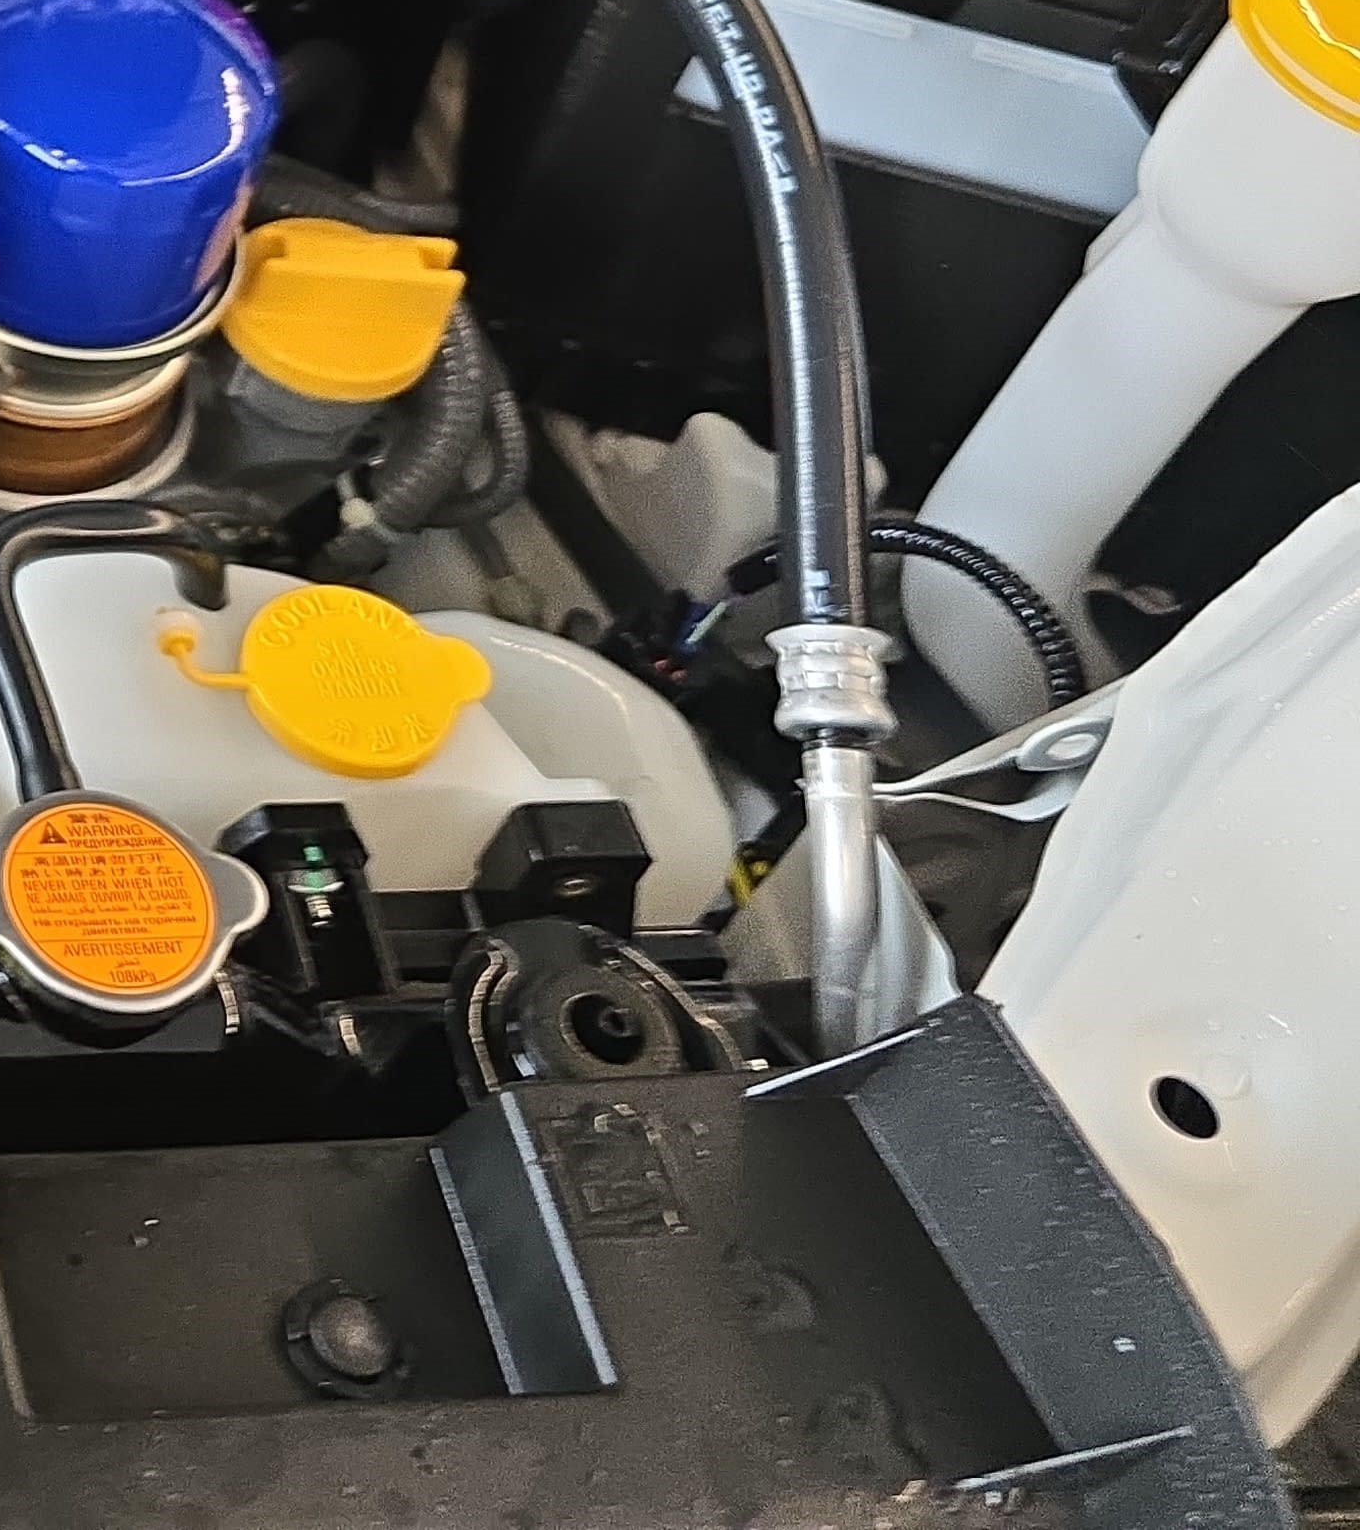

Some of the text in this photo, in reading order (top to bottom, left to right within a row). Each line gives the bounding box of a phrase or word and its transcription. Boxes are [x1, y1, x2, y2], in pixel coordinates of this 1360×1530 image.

[258, 592, 422, 648] COOLANT
[65, 823, 144, 837] WARNING
[22, 876, 184, 892] NEVER OPEN WHEN HOT
[26, 892, 41, 904] NE
[47, 891, 86, 904] JAMAIS
[63, 940, 184, 958] AVERTISSEMENT
[109, 970, 157, 984] 108kPa
